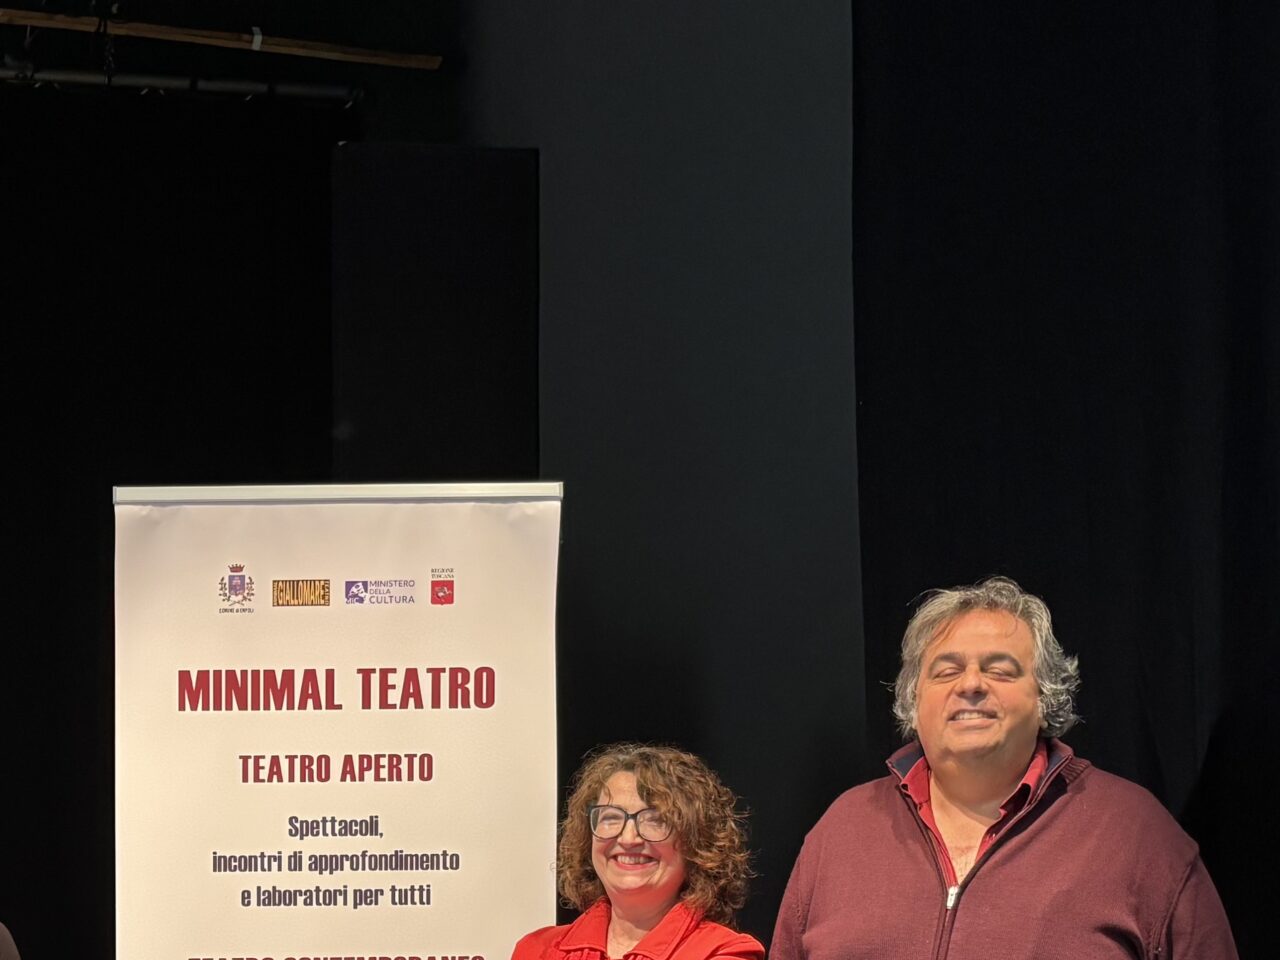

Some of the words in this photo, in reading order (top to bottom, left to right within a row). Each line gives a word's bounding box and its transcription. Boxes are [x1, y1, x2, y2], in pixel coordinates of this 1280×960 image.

[278, 581, 325, 604] GIALLOMARE
[370, 596, 415, 604] CULTURA
[178, 669, 342, 711] MINIMAL
[357, 667, 495, 709] TEATRO
[239, 755, 330, 783] TEATRO
[340, 753, 433, 782] APERTO
[289, 815, 383, 840] Spettacoli,
[213, 851, 282, 872] incontri
[288, 851, 302, 871] di
[308, 850, 459, 875] approfondimento
[241, 890, 251, 907] e
[257, 885, 347, 906] laboratori
[353, 889, 384, 909] per
[390, 884, 430, 905] tutti
